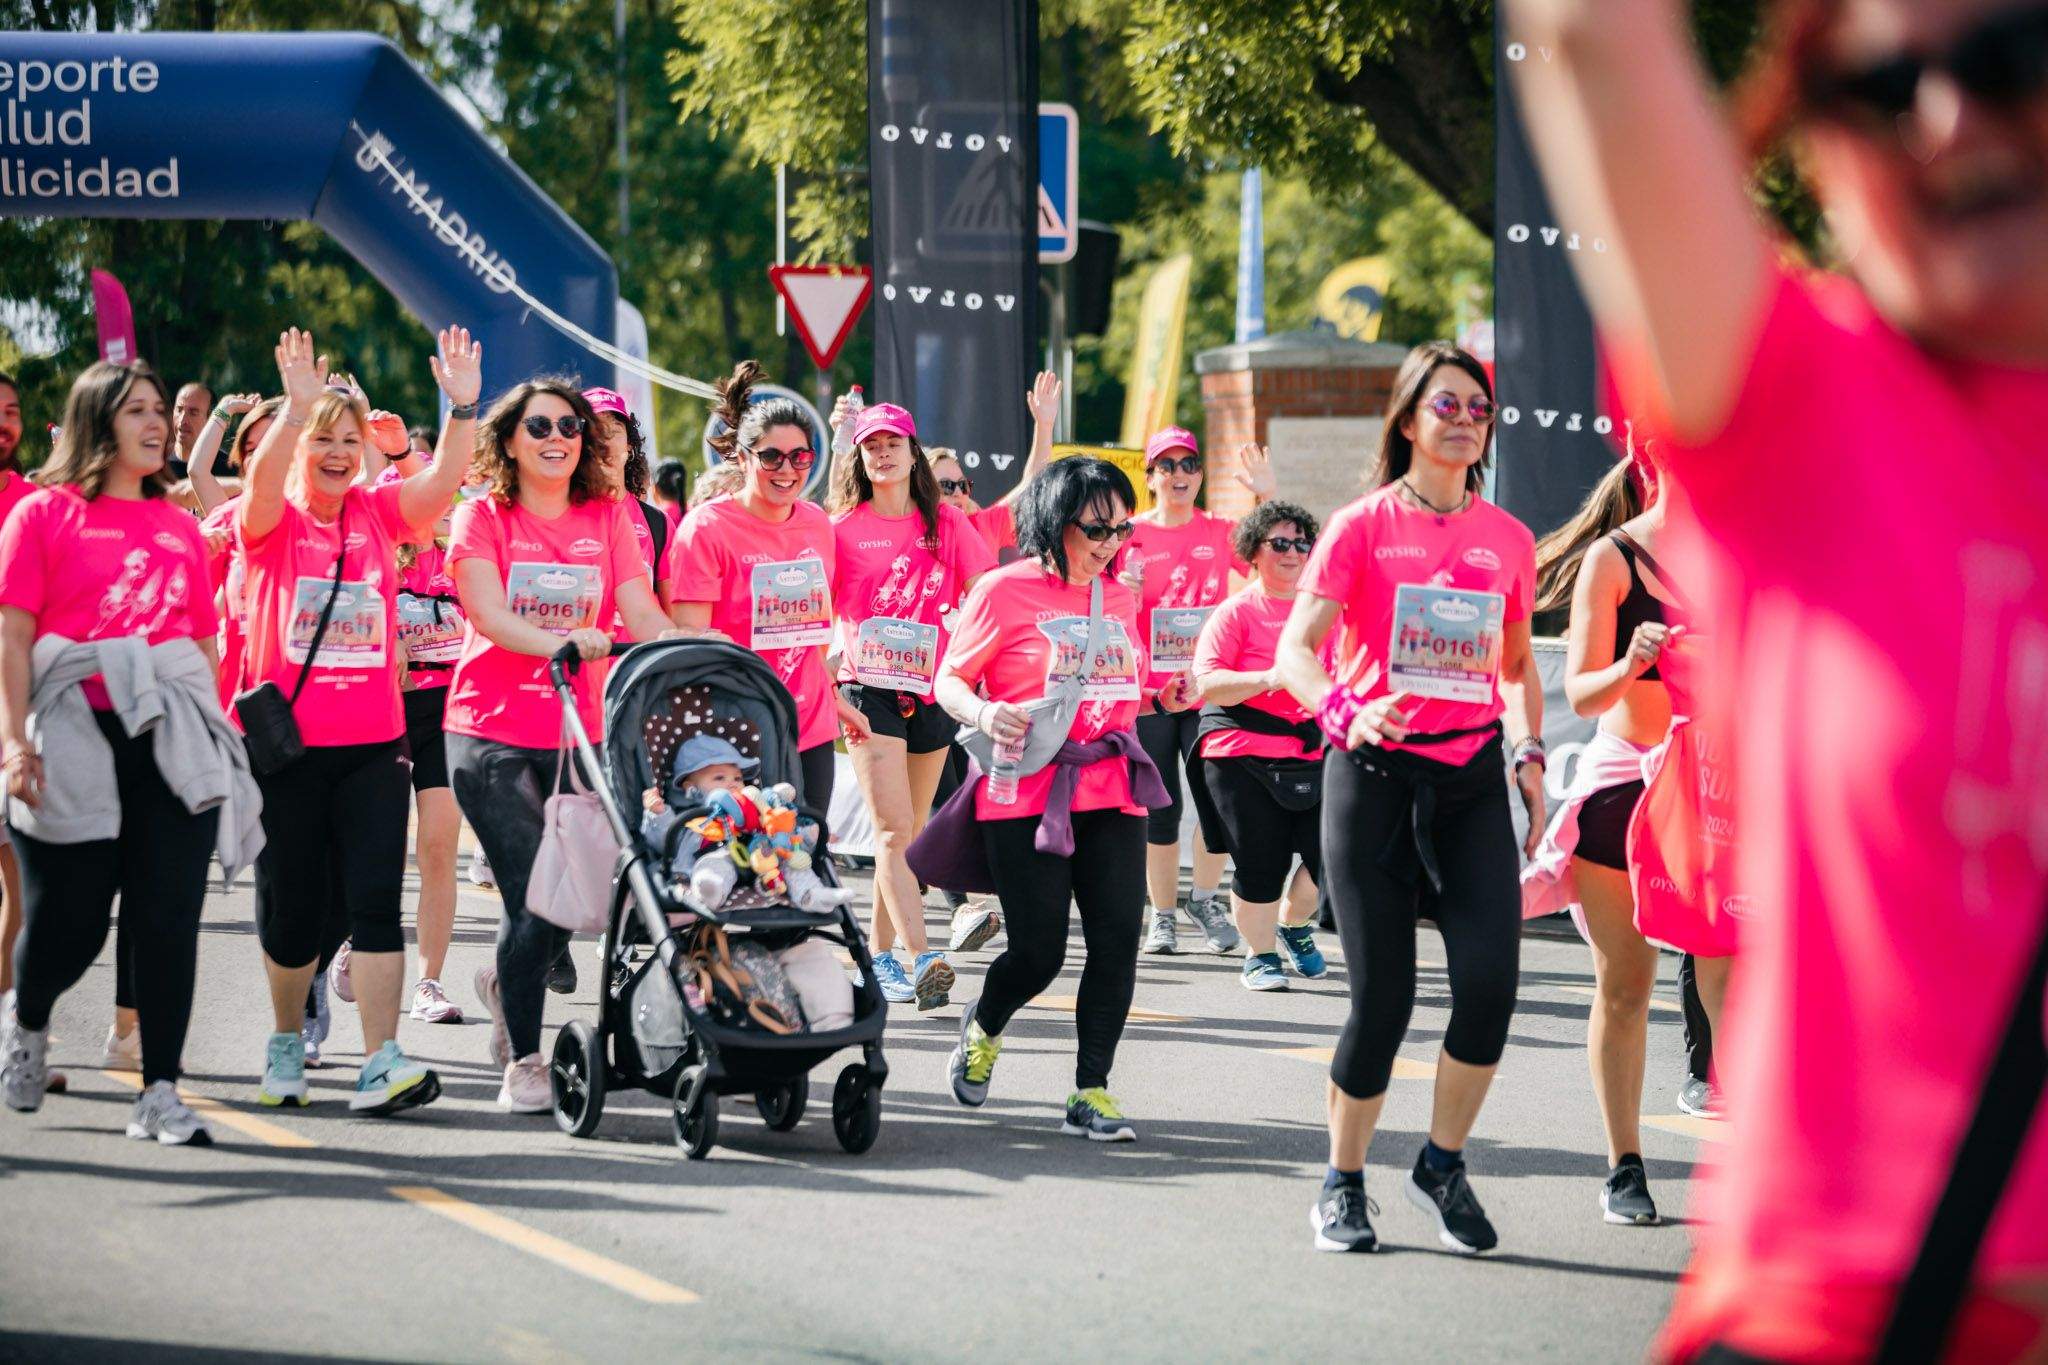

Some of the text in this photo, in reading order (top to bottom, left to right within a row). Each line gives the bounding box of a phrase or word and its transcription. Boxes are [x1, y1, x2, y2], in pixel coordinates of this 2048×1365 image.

[0, 98, 91, 145] lud
[1, 157, 179, 197] licidad
[392, 168, 517, 294] MADRID
[858, 539, 892, 550] OYSHO
[539, 603, 573, 618] 016
[781, 599, 809, 614] 016
[1432, 637, 1474, 657] 016
[884, 649, 913, 663] 016
